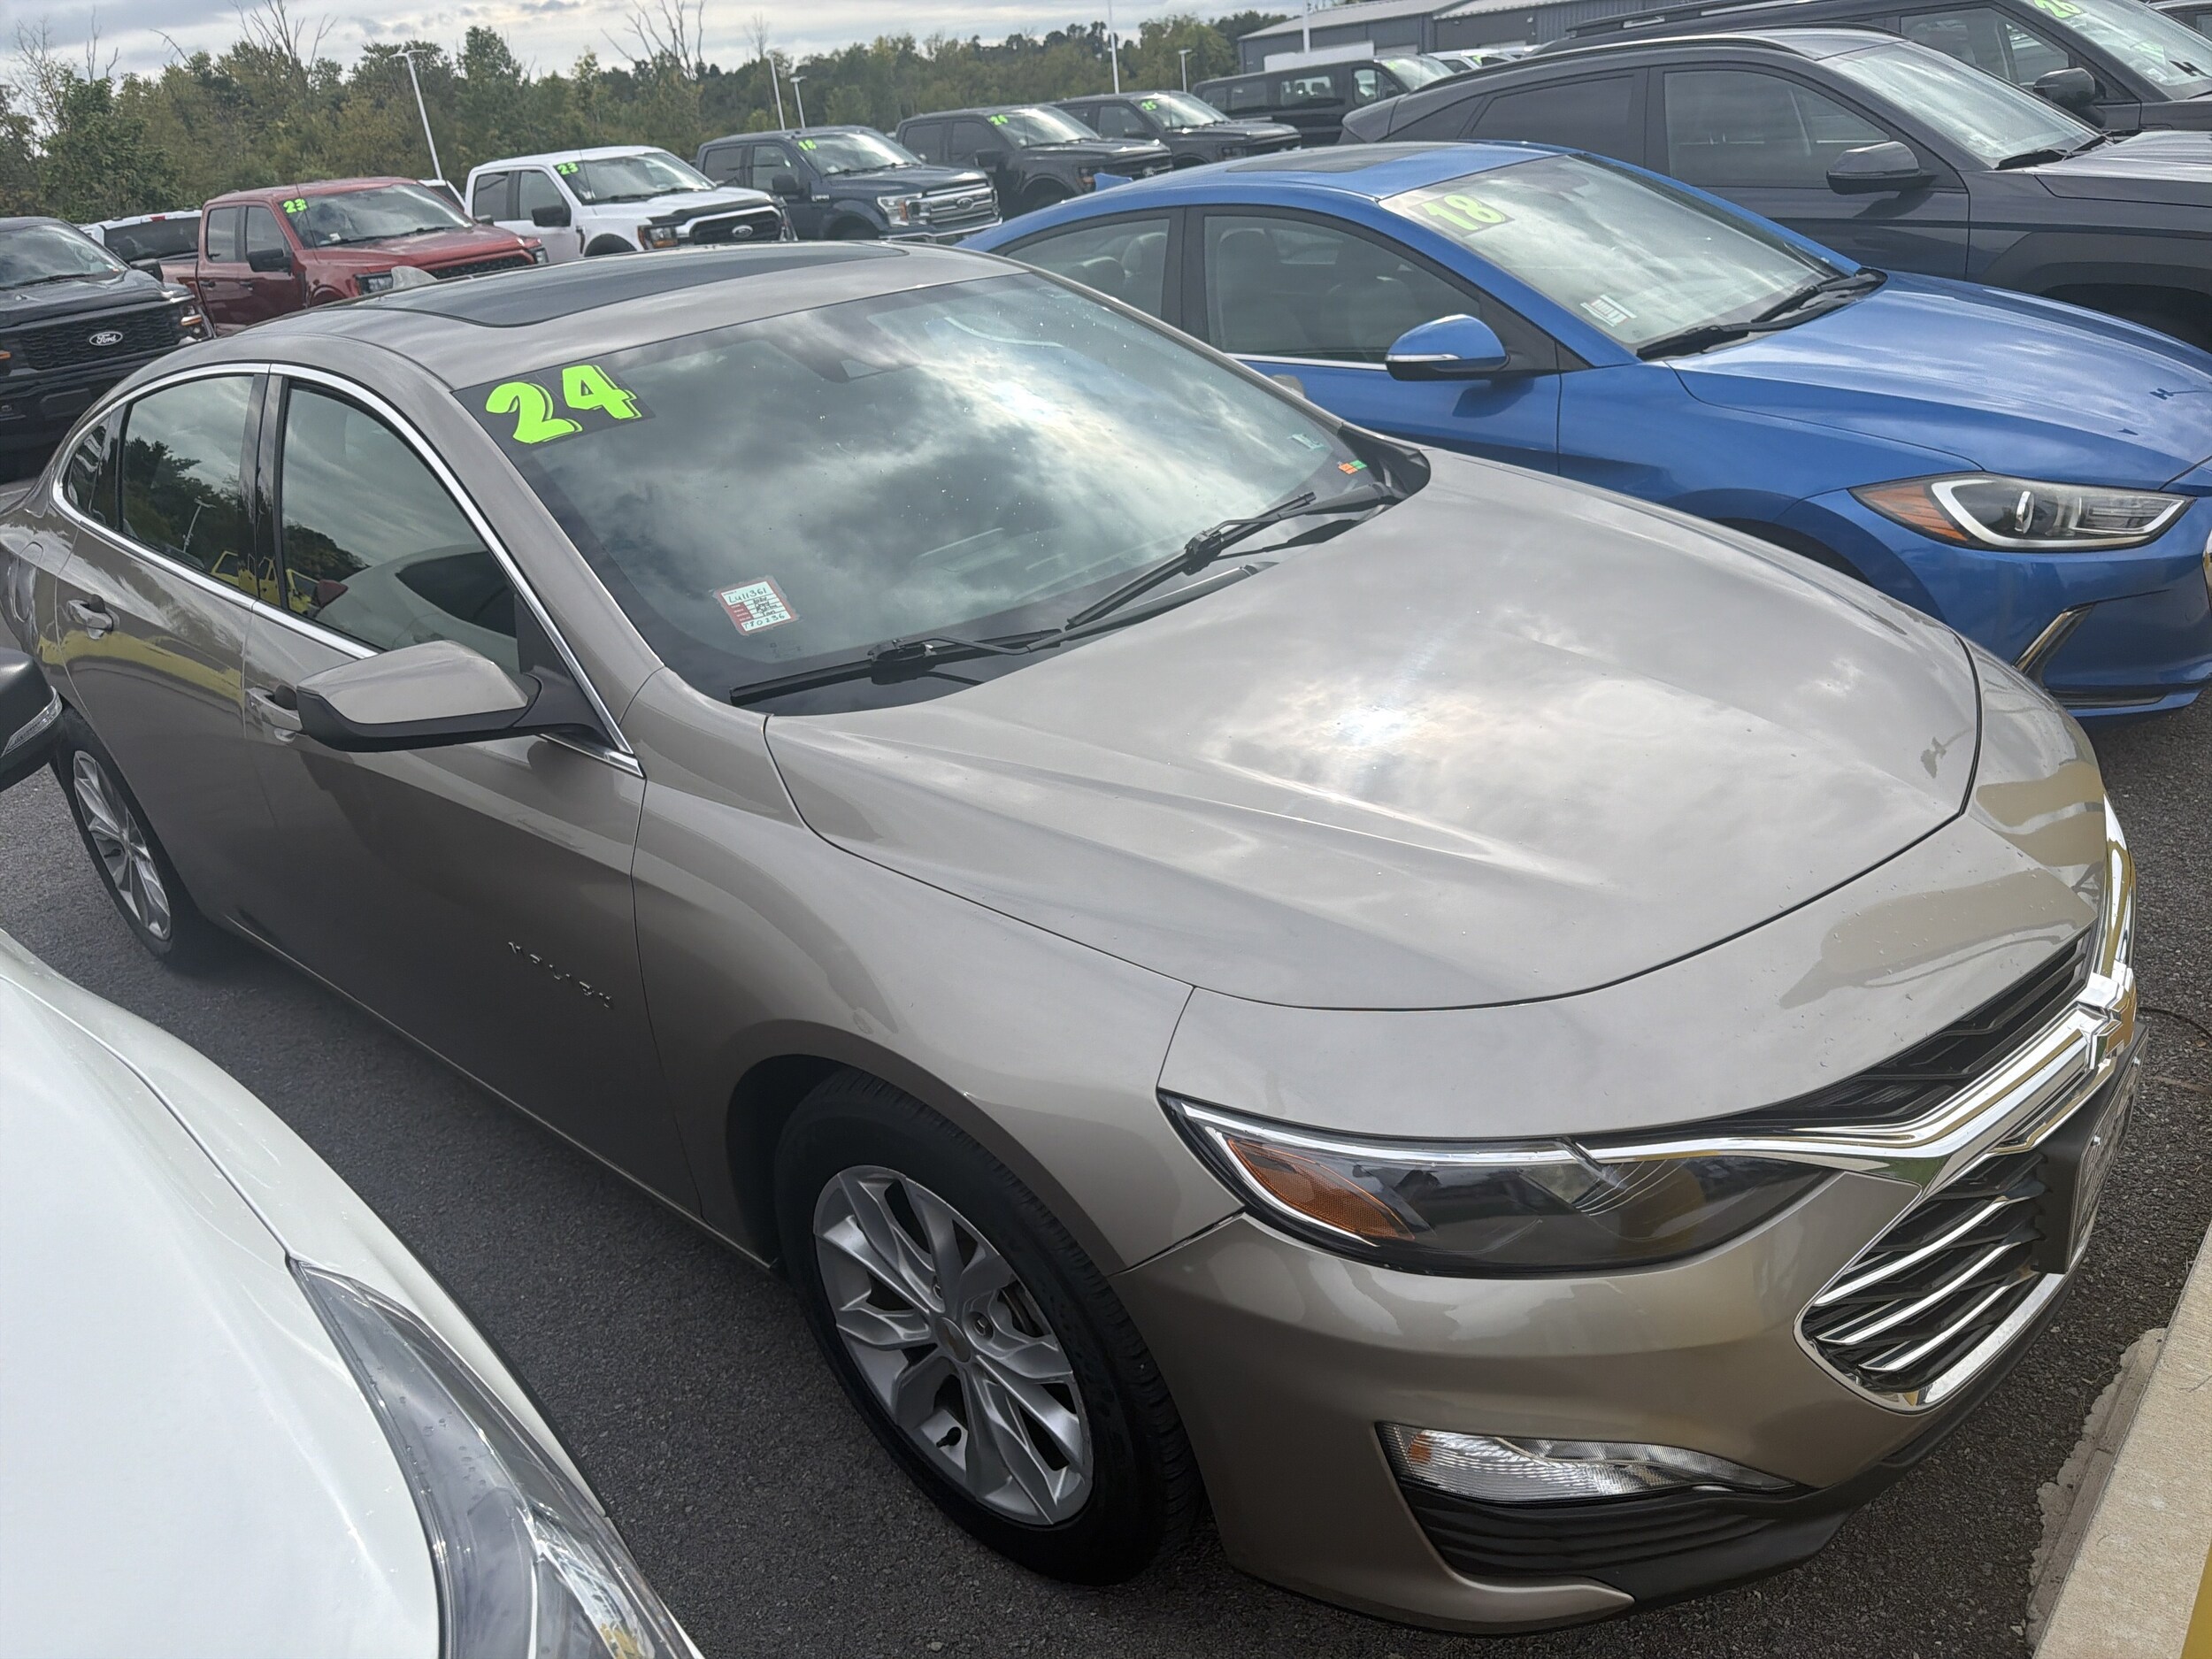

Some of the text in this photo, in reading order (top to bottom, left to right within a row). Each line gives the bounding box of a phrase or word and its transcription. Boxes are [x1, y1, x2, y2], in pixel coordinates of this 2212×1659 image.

[557, 162, 579, 175] 23
[283, 198, 307, 213] 23
[1421, 195, 1505, 230] 18
[95, 333, 117, 344] Ford
[486, 365, 642, 444] 24
